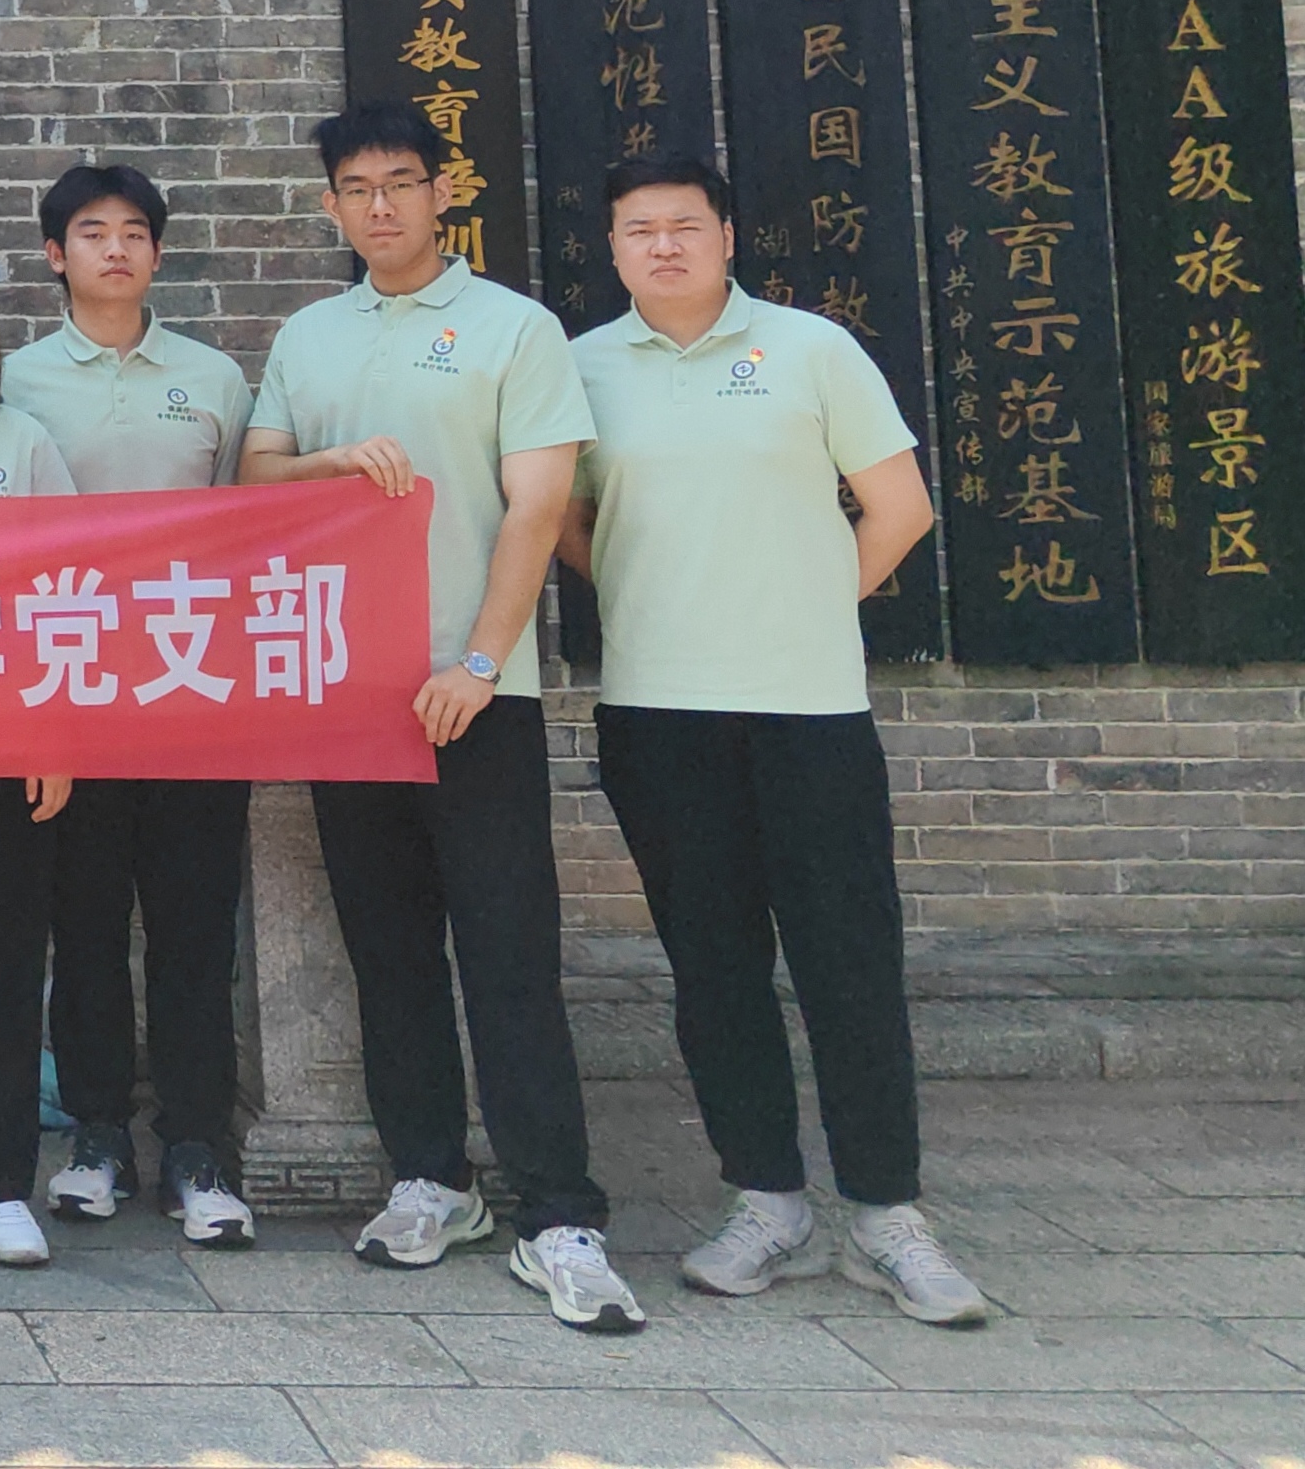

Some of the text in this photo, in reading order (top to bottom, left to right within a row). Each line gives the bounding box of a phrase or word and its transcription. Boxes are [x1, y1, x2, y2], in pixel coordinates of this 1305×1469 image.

[942, 226, 989, 507] 中共中央宣传部
